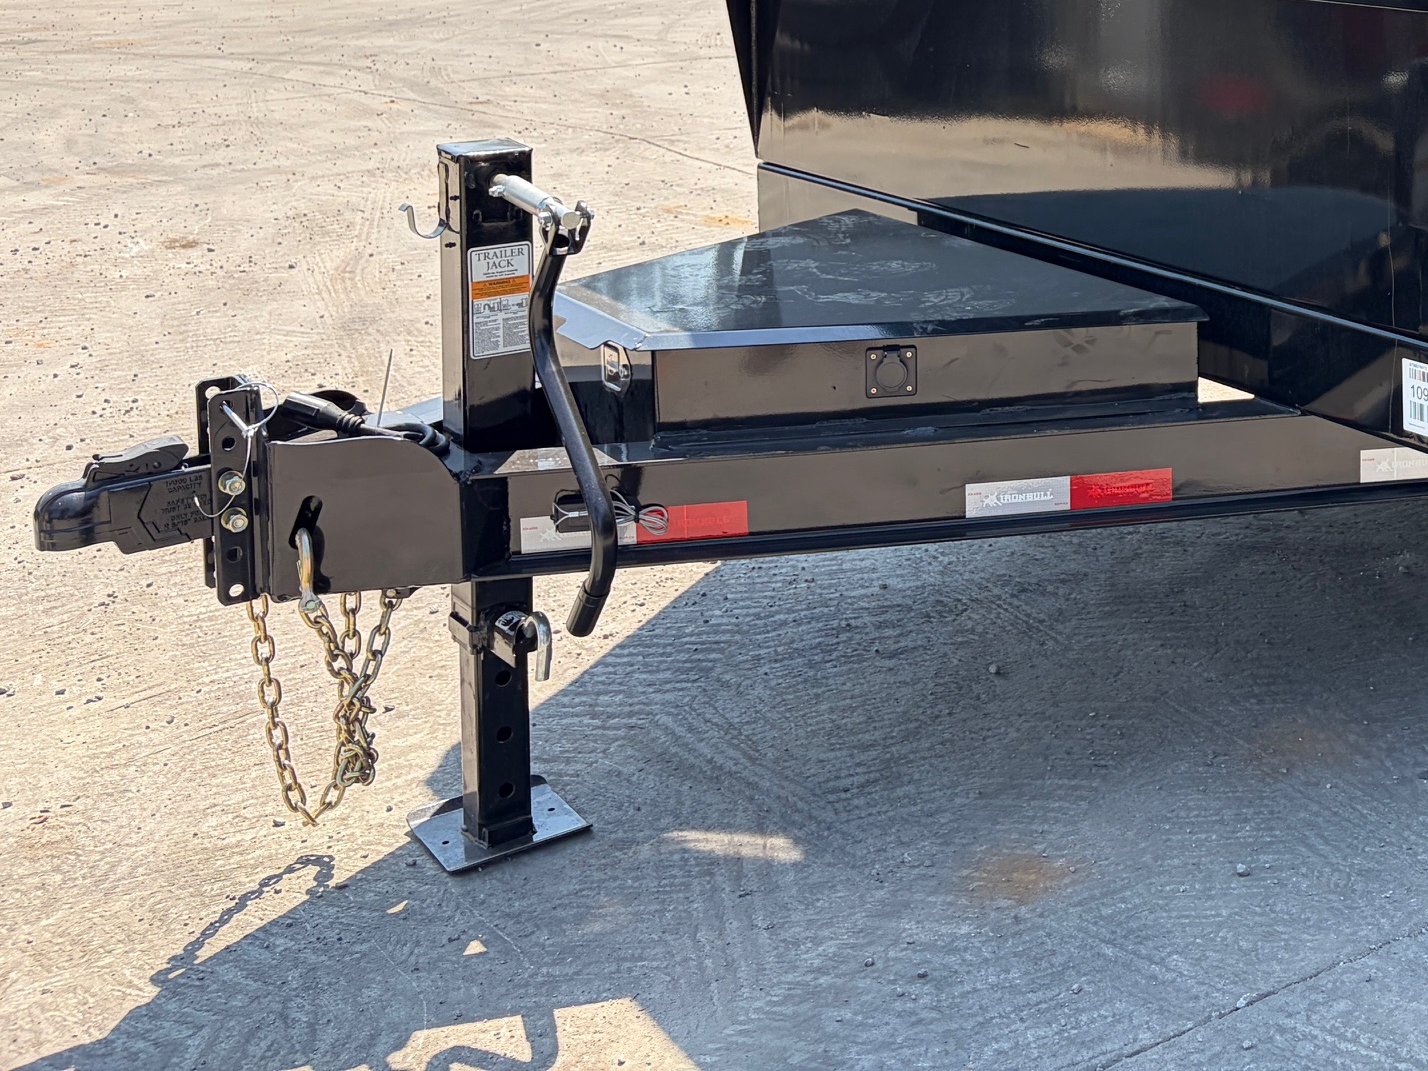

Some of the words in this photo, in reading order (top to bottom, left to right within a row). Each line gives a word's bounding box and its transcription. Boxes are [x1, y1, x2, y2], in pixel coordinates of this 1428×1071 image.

[475, 247, 525, 262] TRAILER
[486, 259, 514, 271] JACK
[168, 482, 202, 493] CAPACITY
[1000, 488, 1053, 504] IRONBULL
